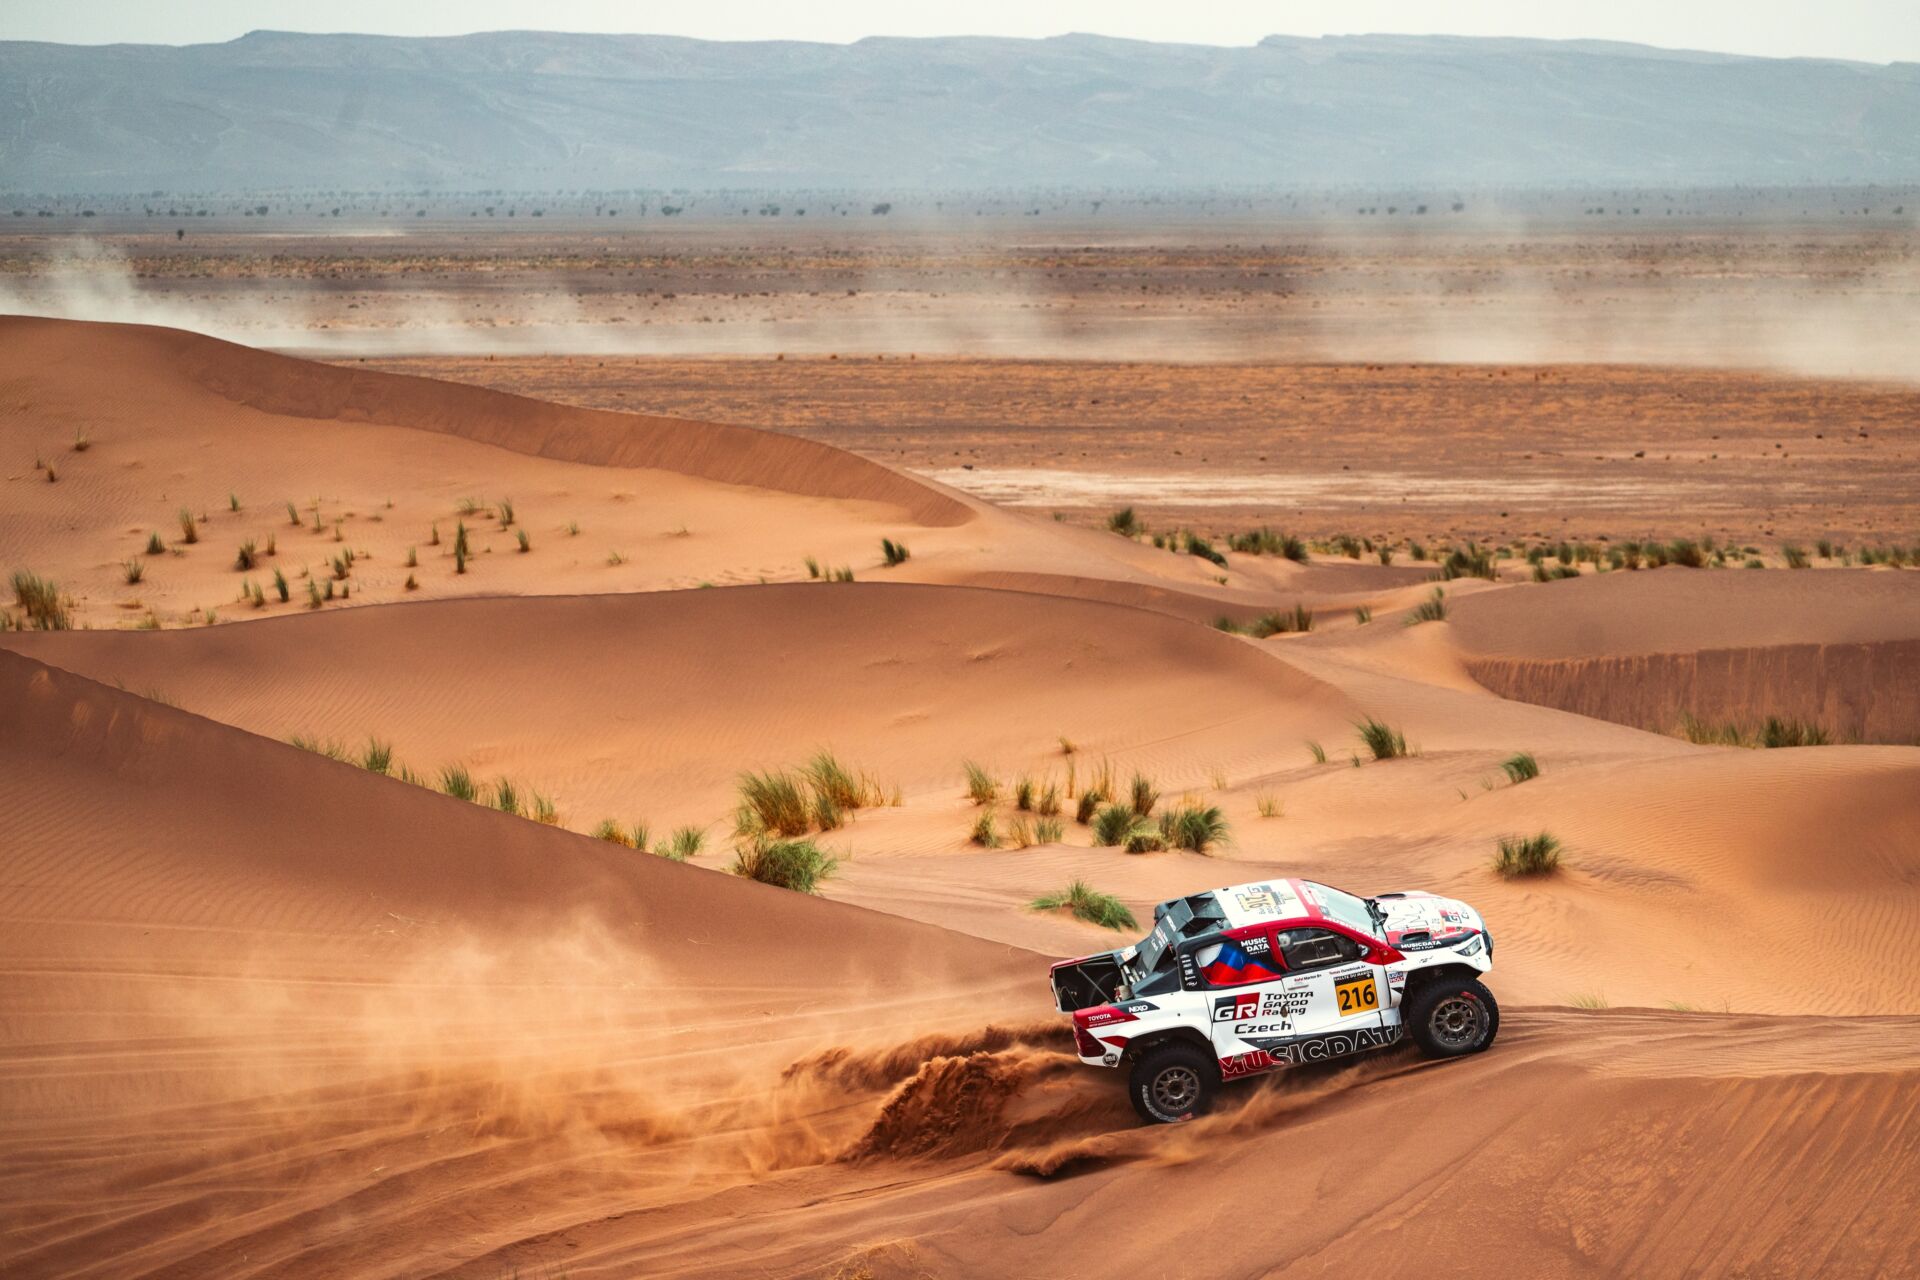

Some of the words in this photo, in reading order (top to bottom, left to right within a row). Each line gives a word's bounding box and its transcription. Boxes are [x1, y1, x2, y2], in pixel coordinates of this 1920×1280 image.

[1241, 937, 1267, 947] MUSIC
[1401, 940, 1441, 948] MUSICDATA
[1246, 943, 1270, 952] DATA
[1265, 991, 1314, 1000] TOYOTA
[1340, 984, 1375, 1011] 216
[1263, 999, 1308, 1008] GAZOO
[1213, 1003, 1257, 1021] GR
[1088, 1013, 1111, 1021] TOYOTA
[1234, 1021, 1292, 1034] Czech
